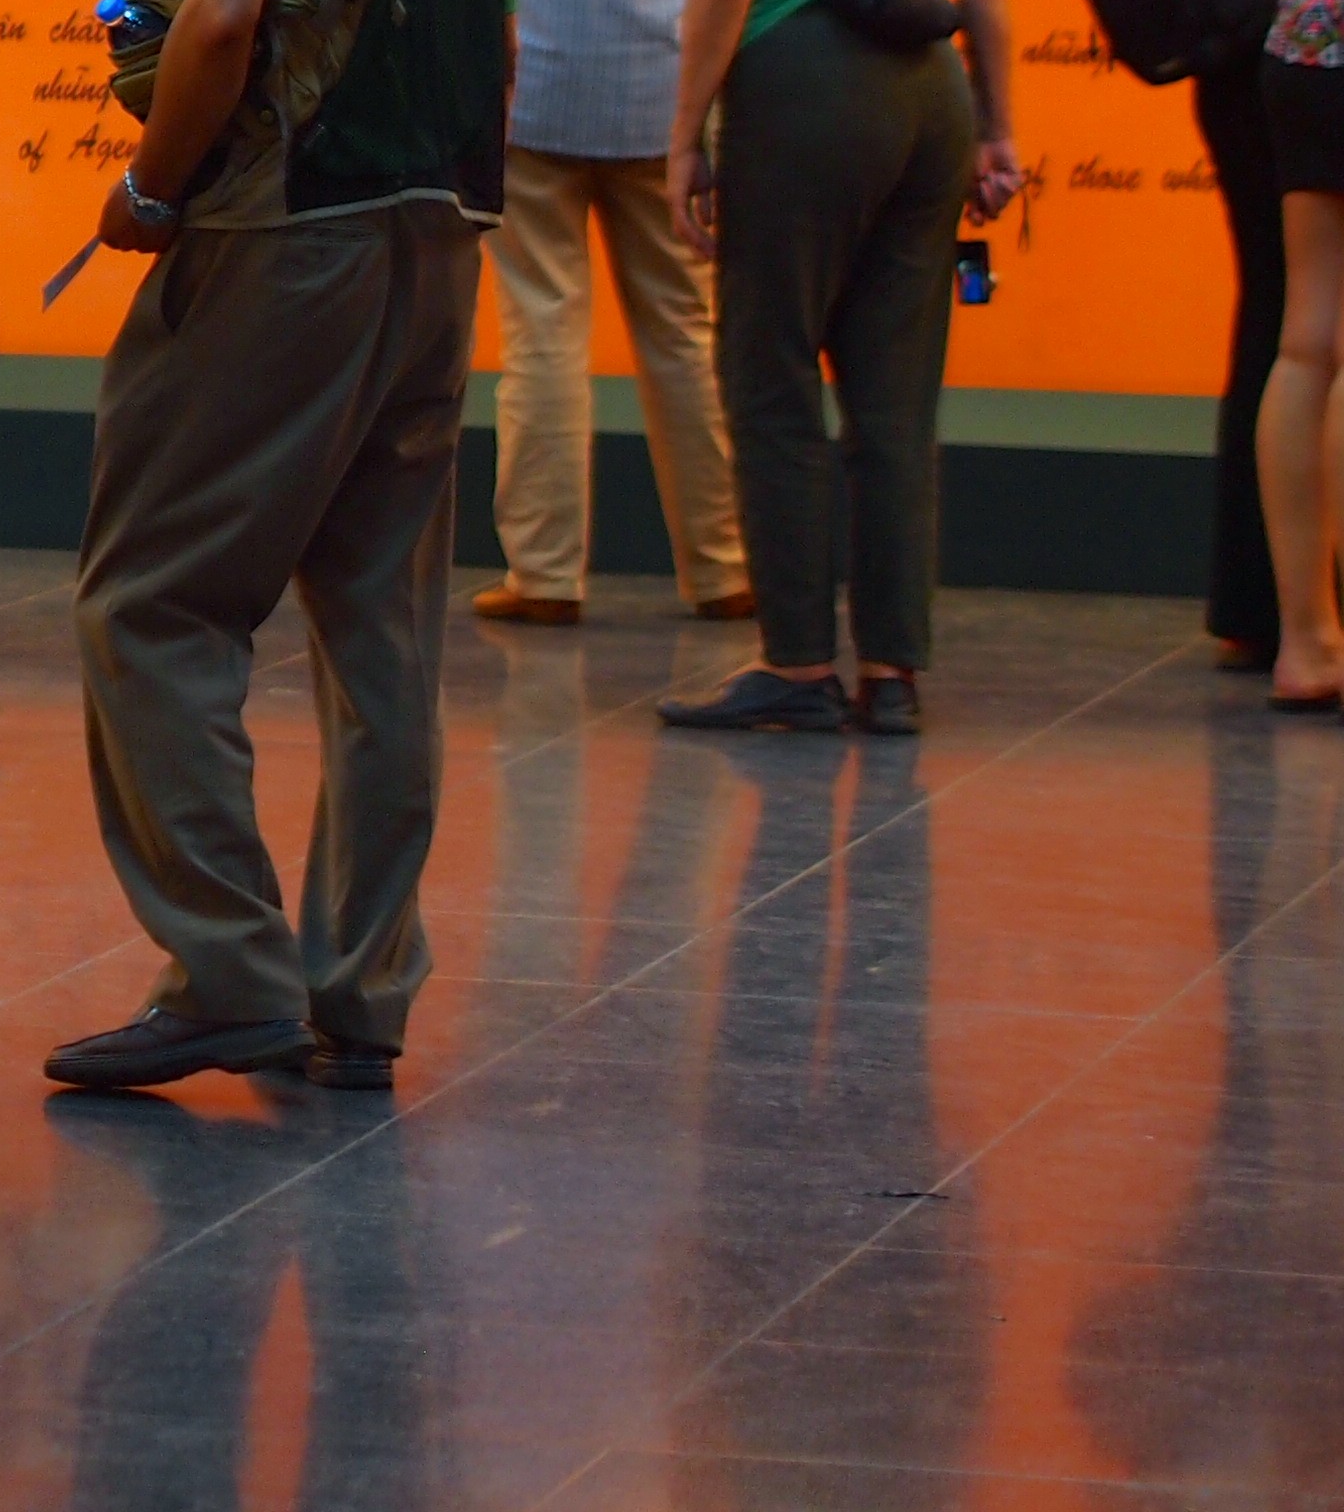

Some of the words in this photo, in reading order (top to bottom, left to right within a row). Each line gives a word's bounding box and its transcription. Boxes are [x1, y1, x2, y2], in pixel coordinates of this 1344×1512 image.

[18, 130, 48, 173] of
[68, 123, 139, 171] Agen
[1069, 154, 1141, 191] those
